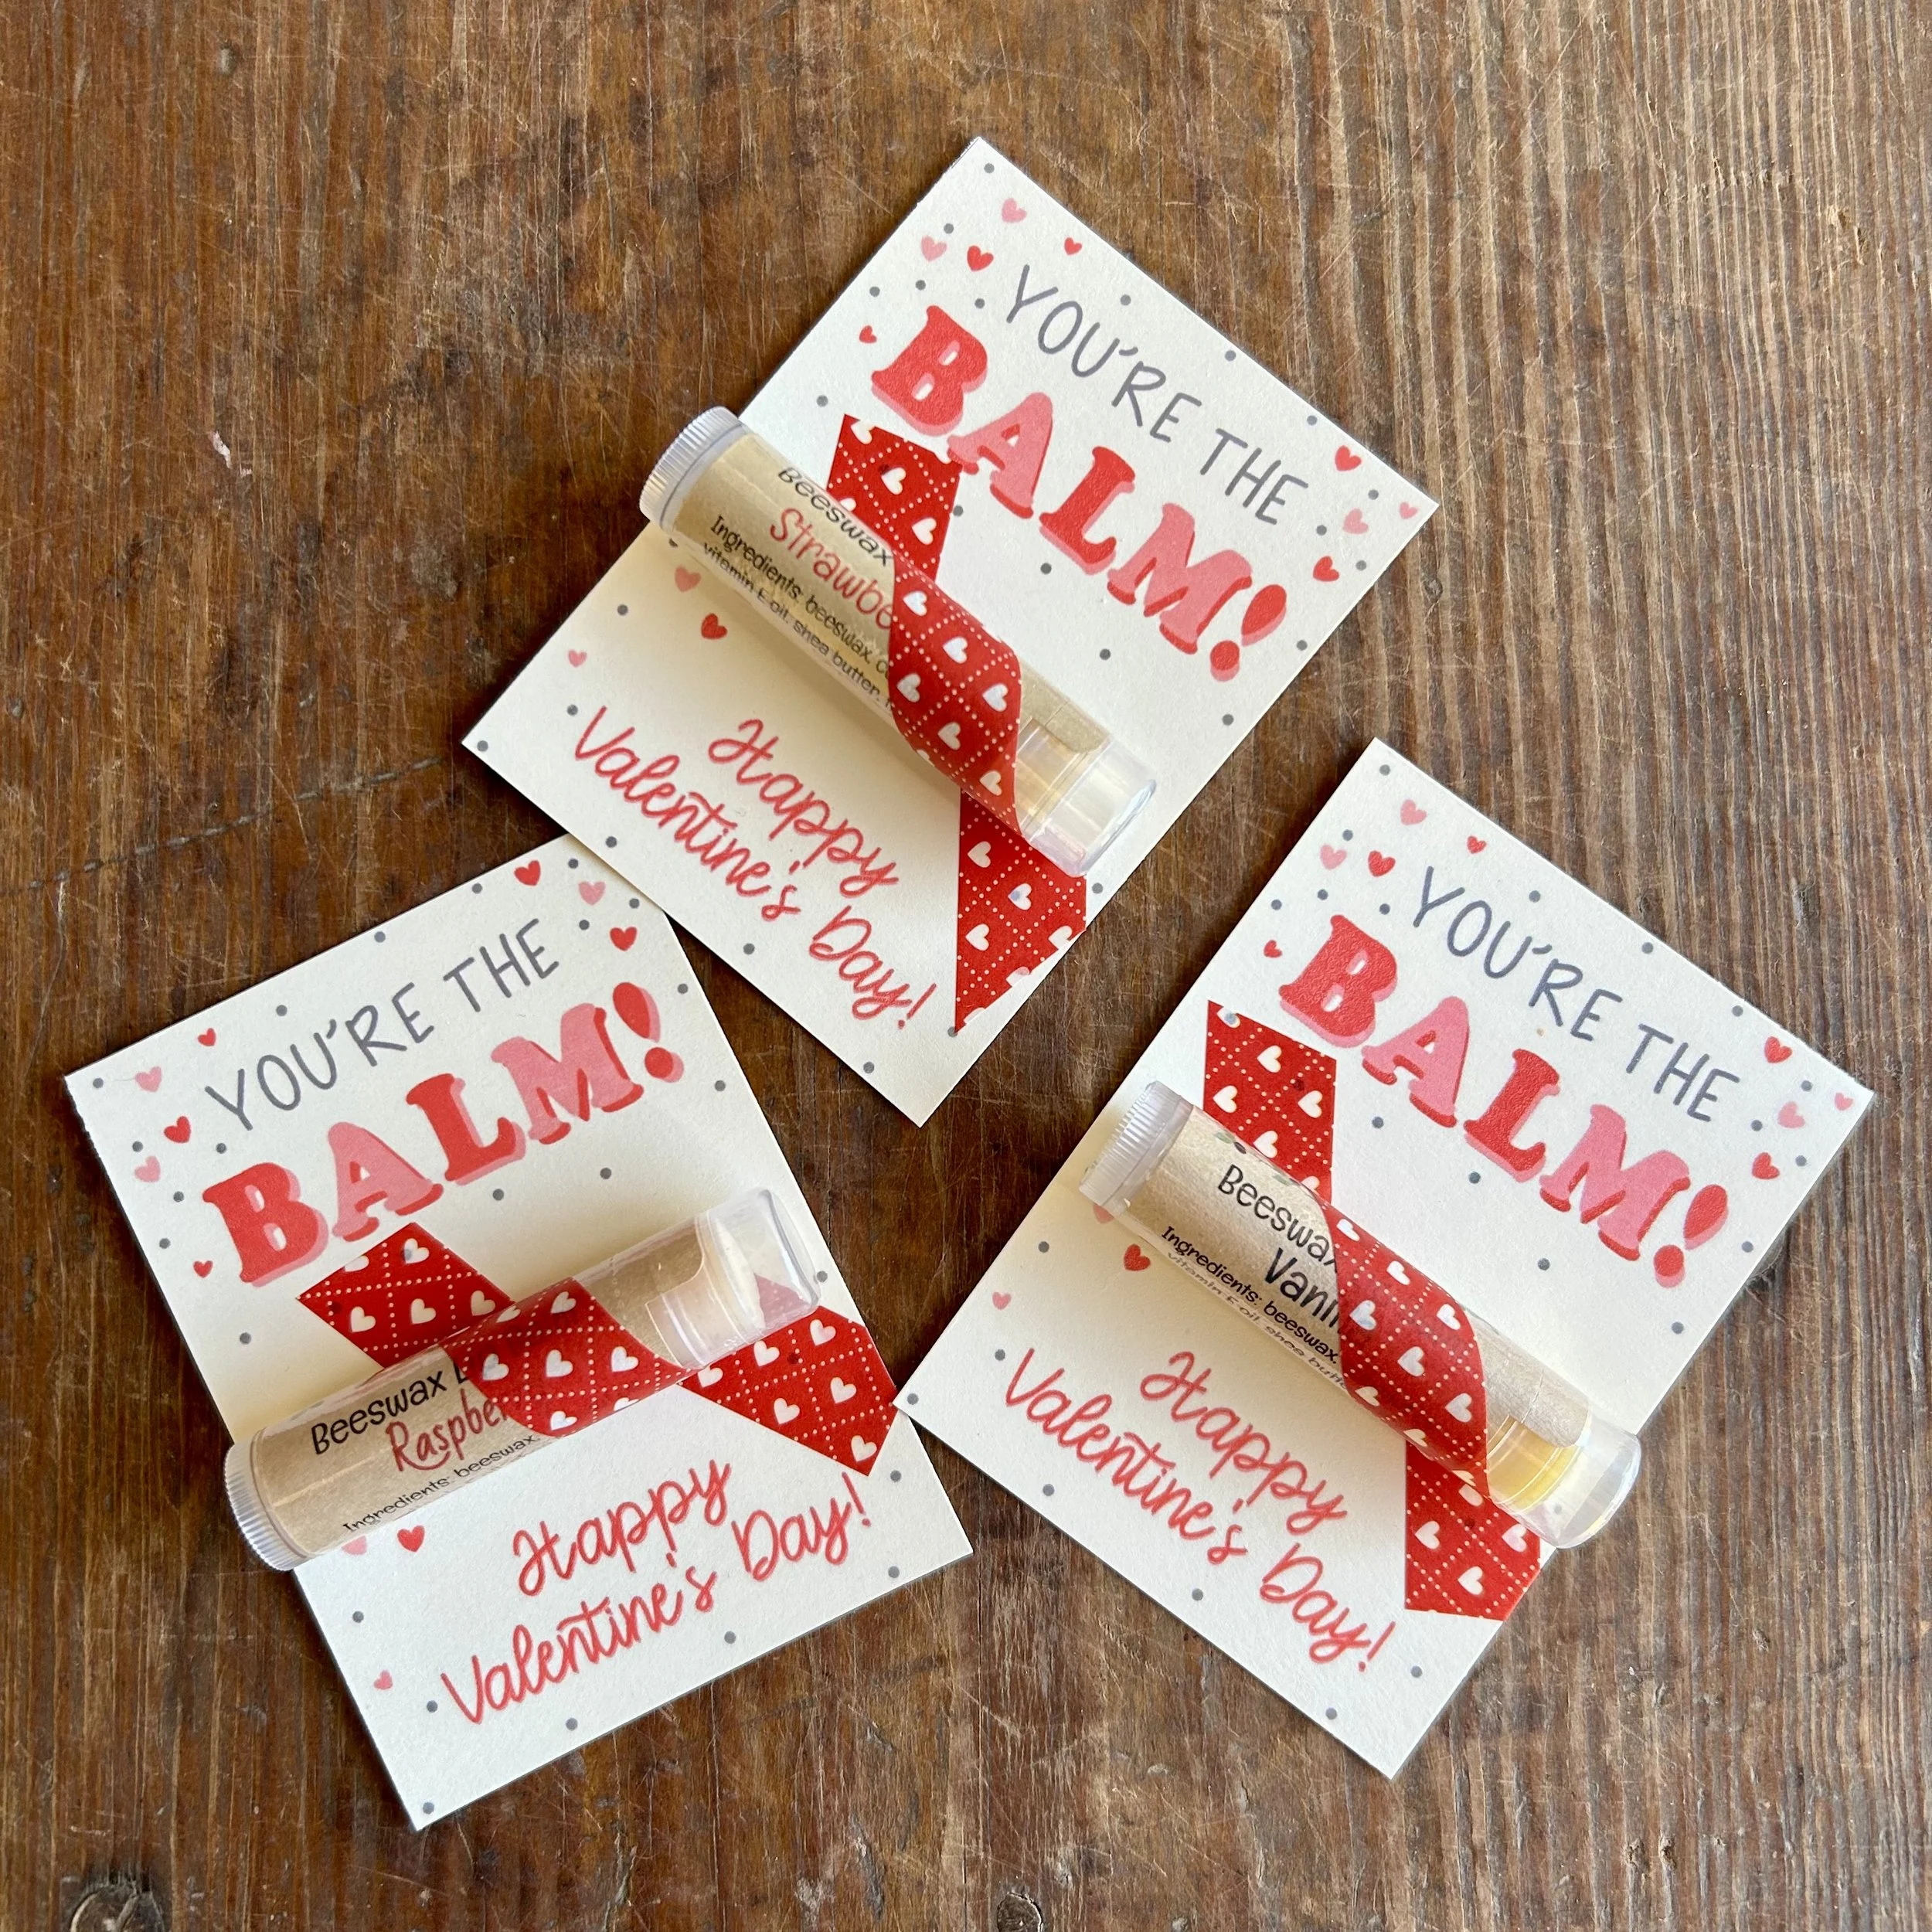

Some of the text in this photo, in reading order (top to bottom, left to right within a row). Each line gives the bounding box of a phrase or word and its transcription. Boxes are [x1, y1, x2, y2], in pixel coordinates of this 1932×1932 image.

[871, 304, 1287, 682] BALM!
[1005, 264, 1308, 525] YOU'RE THE
[703, 542, 755, 593] vitamin
[793, 619, 829, 656] shea
[777, 466, 894, 567] Beeswax
[575, 705, 937, 1029] Valentine's Day!
[708, 719, 900, 898] Happy
[204, 917, 560, 1131] YOU'RE THE
[1278, 914, 1730, 1288] BALM!
[1412, 866, 1740, 1123] YOU'RE THE
[202, 981, 685, 1288] BALM!
[1161, 1225, 1263, 1306] Ingredients:
[310, 1370, 447, 1455] Beeswax
[386, 1388, 509, 1472] Raspbe
[1005, 1348, 1396, 1672] Valentine's Day!
[1140, 1351, 1348, 1536] Happy
[440, 1471, 872, 1724] Valentine's Day!
[512, 1458, 732, 1597] Happy
